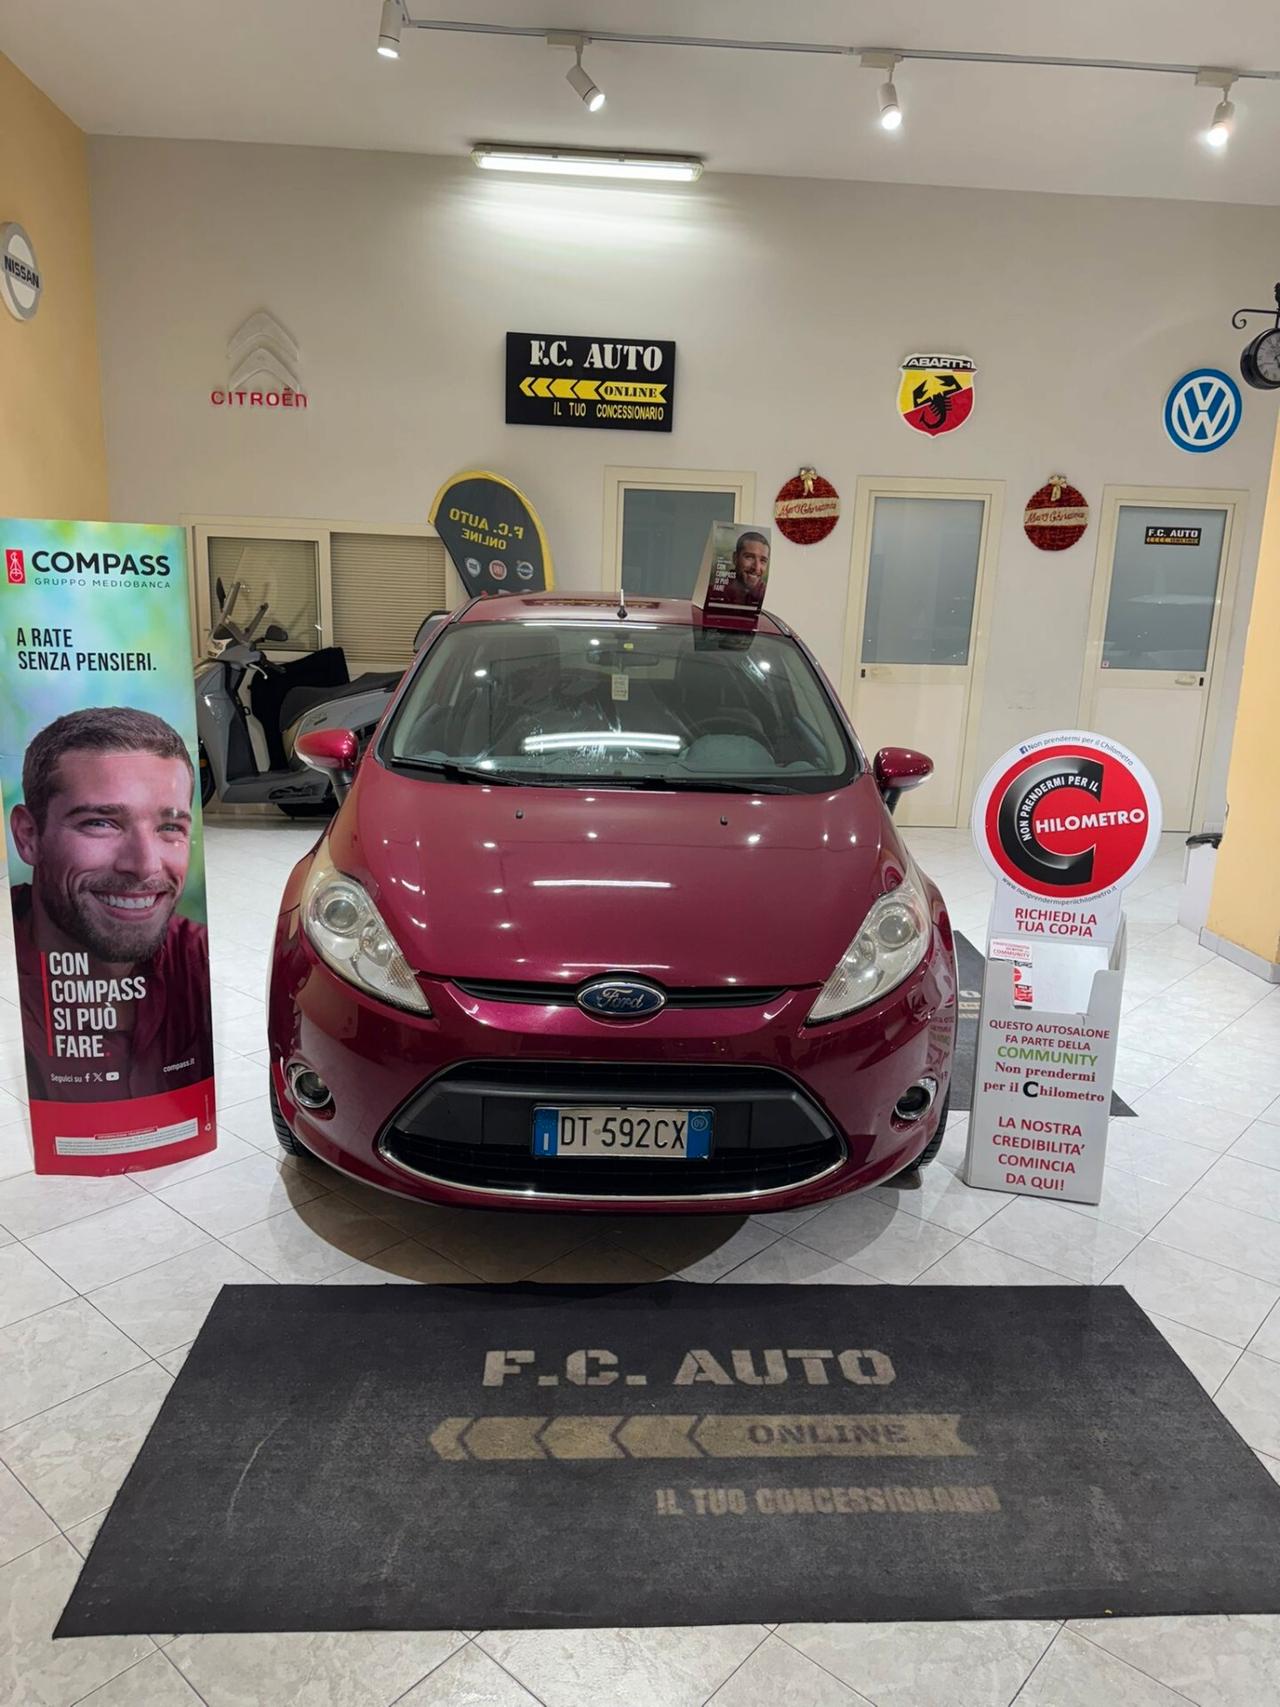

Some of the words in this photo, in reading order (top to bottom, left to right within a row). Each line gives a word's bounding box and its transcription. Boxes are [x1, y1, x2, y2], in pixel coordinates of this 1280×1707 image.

[4, 255, 40, 289] NISSAN
[530, 340, 573, 367] F.C.
[584, 343, 663, 371] AUTO
[908, 358, 971, 368] ABARTH
[604, 385, 657, 398] ONLINE
[553, 401, 562, 416] IL
[569, 402, 586, 417] TUO
[596, 404, 664, 421] CONCESSIONARIO
[1148, 528, 1167, 537] F.C.
[1170, 529, 1199, 538] AUTO
[31, 551, 171, 576] COMPASS
[34, 578, 86, 587] GRUPPO
[92, 579, 171, 589] MEDIOBANCA
[17, 627, 26, 647] A
[31, 628, 73, 648] RATE
[18, 651, 71, 671] SENZA
[76, 652, 157, 671] PENSIERI.
[1027, 740, 1044, 751] Non
[1044, 735, 1081, 748] prendermi
[1082, 737, 1095, 745] per
[1100, 740, 1134, 767] Chilometro
[1067, 775, 1089, 788] PER
[1088, 780, 1099, 792] IL
[1021, 776, 1066, 818] PRENDERMI
[1019, 815, 1033, 842] NON
[1014, 908, 1076, 923] RICHIEDI
[1081, 913, 1097, 925] LA
[1016, 920, 1045, 932] TUA
[1049, 923, 1093, 937] COPIA
[49, 952, 89, 976] CON
[51, 976, 147, 1004] COMPASS
[597, 988, 645, 1008] Ford
[53, 1008, 71, 1031] SI
[77, 1003, 117, 1031] PUÒ
[989, 1019, 1033, 1032] QUESTO
[1036, 1023, 1110, 1040] AUTOSALONE
[1005, 1034, 1018, 1044] FA
[1021, 1036, 1055, 1048] PARTE
[1058, 1040, 1091, 1051] DELLA
[163, 1058, 195, 1073] compass.it
[997, 1046, 1098, 1067] COMMUNITY
[50, 1072, 73, 1084] Seguici
[994, 1061, 1021, 1075] Non
[1025, 1065, 1096, 1083] prendermi
[983, 1082, 1006, 1093] per
[1010, 1081, 1019, 1093] il
[1022, 1081, 1105, 1103] Chilometro
[561, 1116, 592, 1147] DT
[601, 1117, 687, 1149] 592CX
[998, 1116, 1016, 1129] LA
[1020, 1119, 1083, 1137] NOSTRA
[998, 1153, 1075, 1174] COMINCIA
[1005, 1172, 1027, 1186] DA
[1031, 1176, 1065, 1191] QUI!
[482, 1350, 647, 1386] F.C.
[673, 1349, 897, 1386] AUTO
[747, 1423, 907, 1445] ONLINE
[656, 1488, 683, 1515] IL
[691, 1487, 747, 1515] TUO
[755, 1485, 1001, 1515] CONCESSIONARIO
